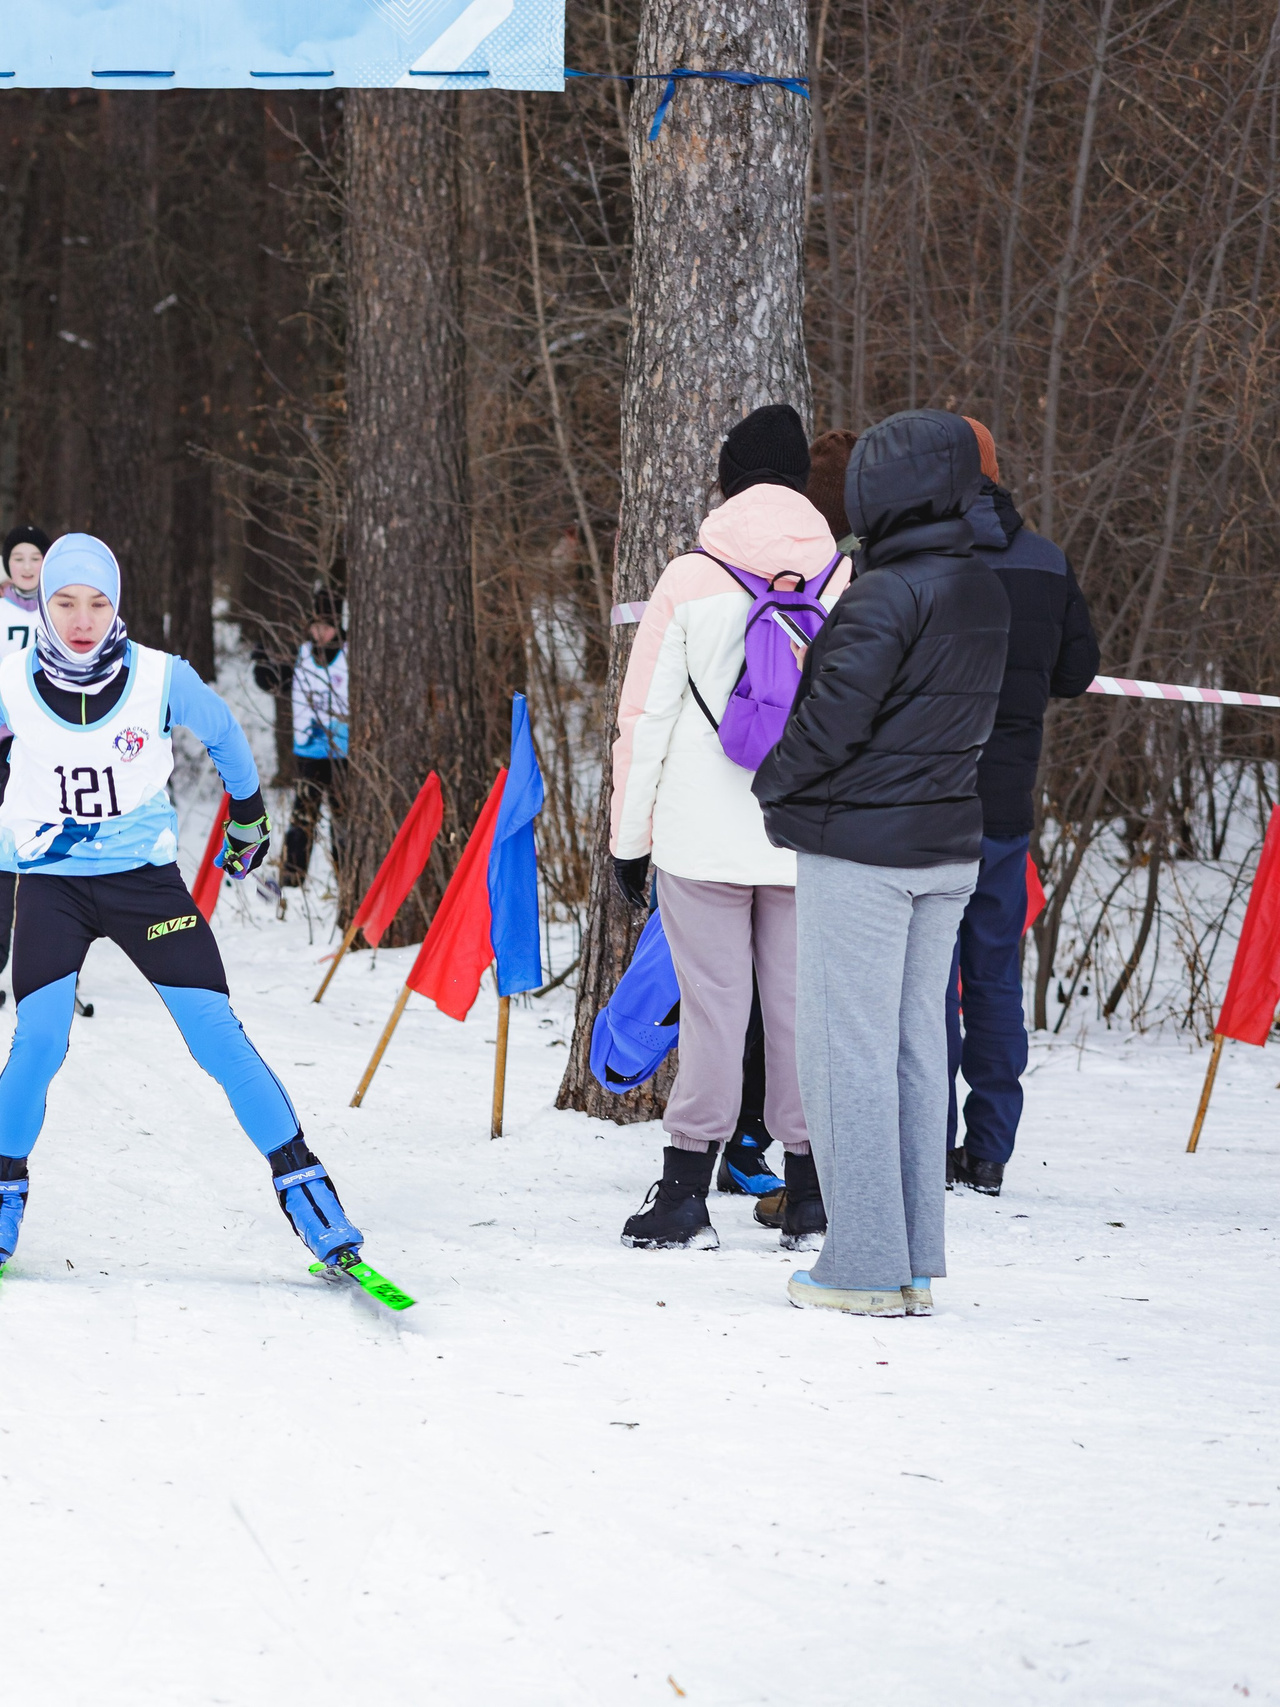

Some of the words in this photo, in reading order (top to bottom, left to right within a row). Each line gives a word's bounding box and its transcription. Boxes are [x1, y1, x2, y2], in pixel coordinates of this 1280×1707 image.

[8, 626, 38, 650] 7
[54, 766, 122, 817] 121
[148, 915, 197, 940] KV+
[281, 1169, 317, 1186] SPINE
